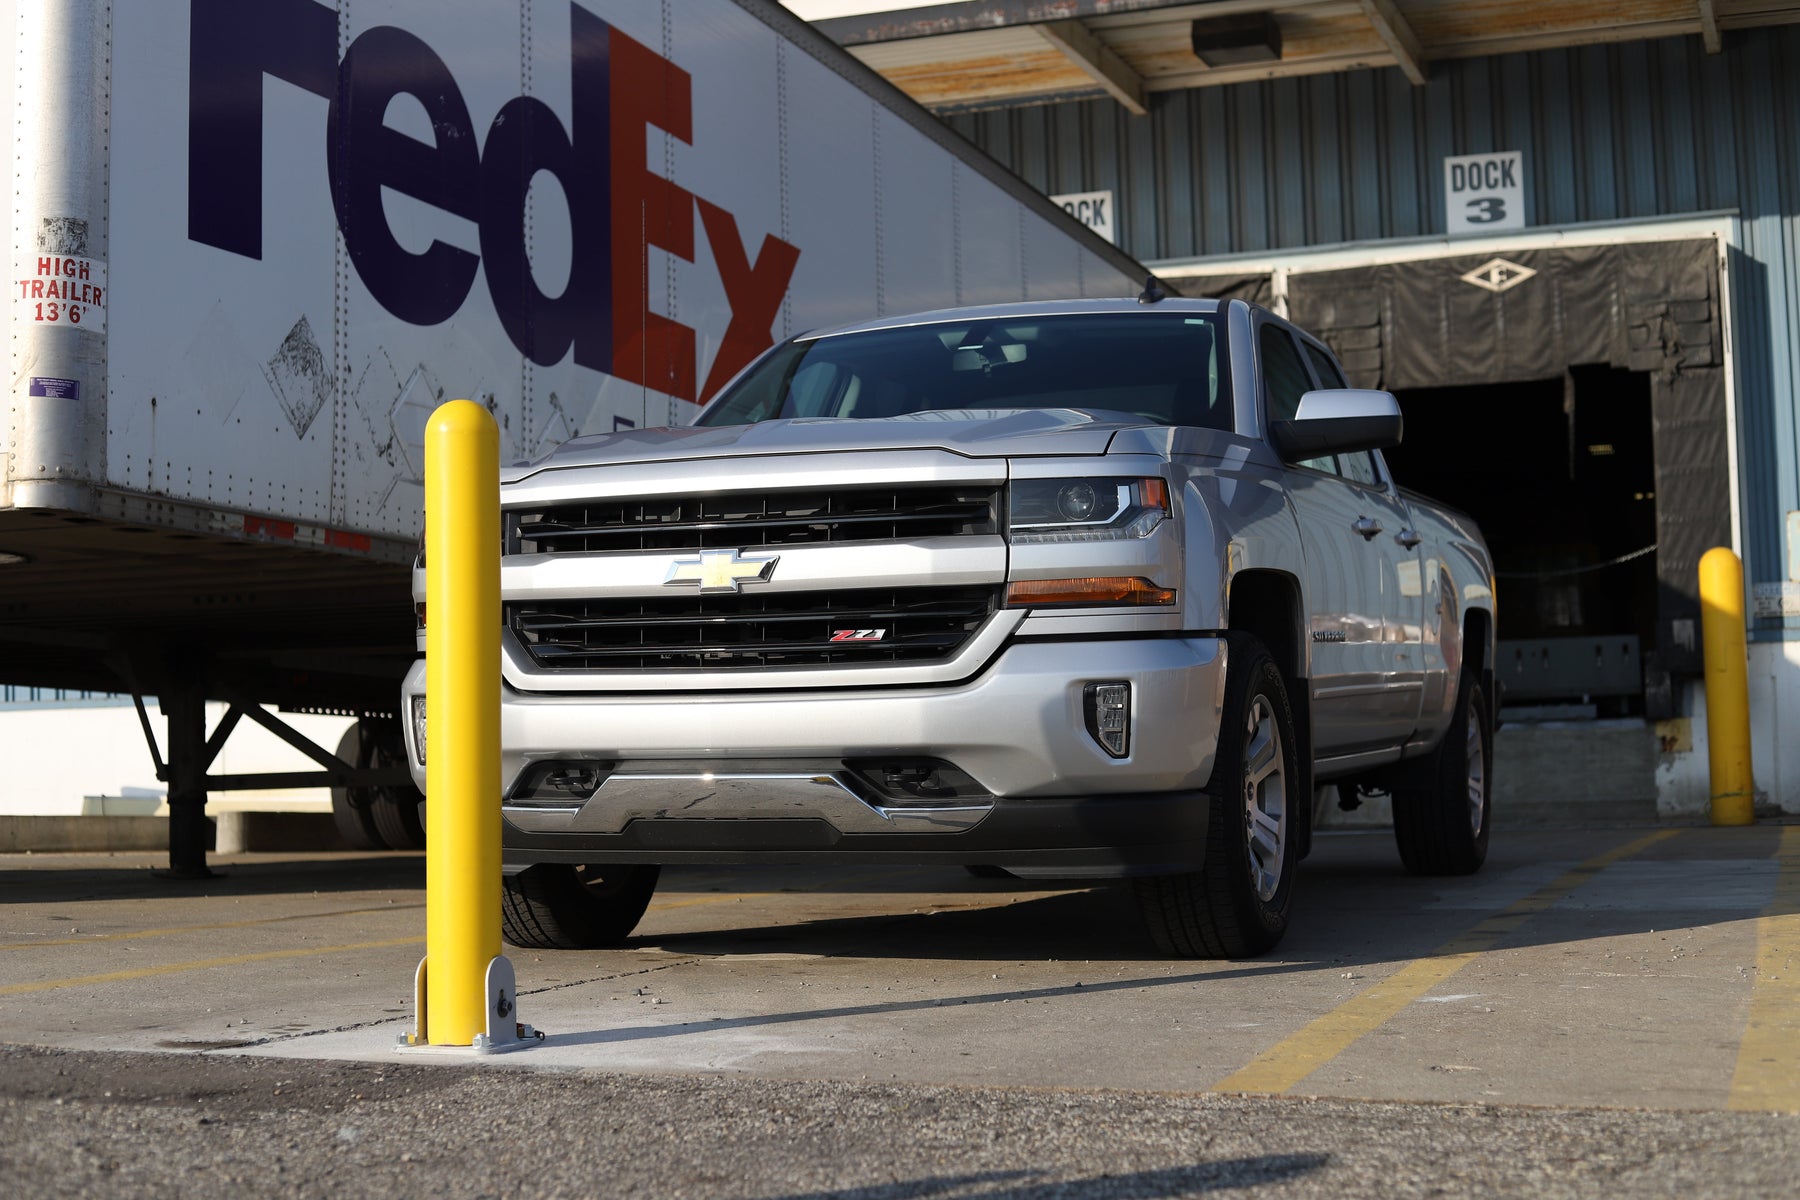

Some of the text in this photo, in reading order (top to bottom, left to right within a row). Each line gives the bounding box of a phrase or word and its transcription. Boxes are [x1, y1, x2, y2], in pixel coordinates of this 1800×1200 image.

[1451, 158, 1517, 192] DOCK
[1063, 198, 1106, 227] CK
[1466, 197, 1507, 224] 3
[37, 256, 90, 281] HIGH
[19, 279, 102, 307] TRAILER
[830, 629, 887, 642] Z71
